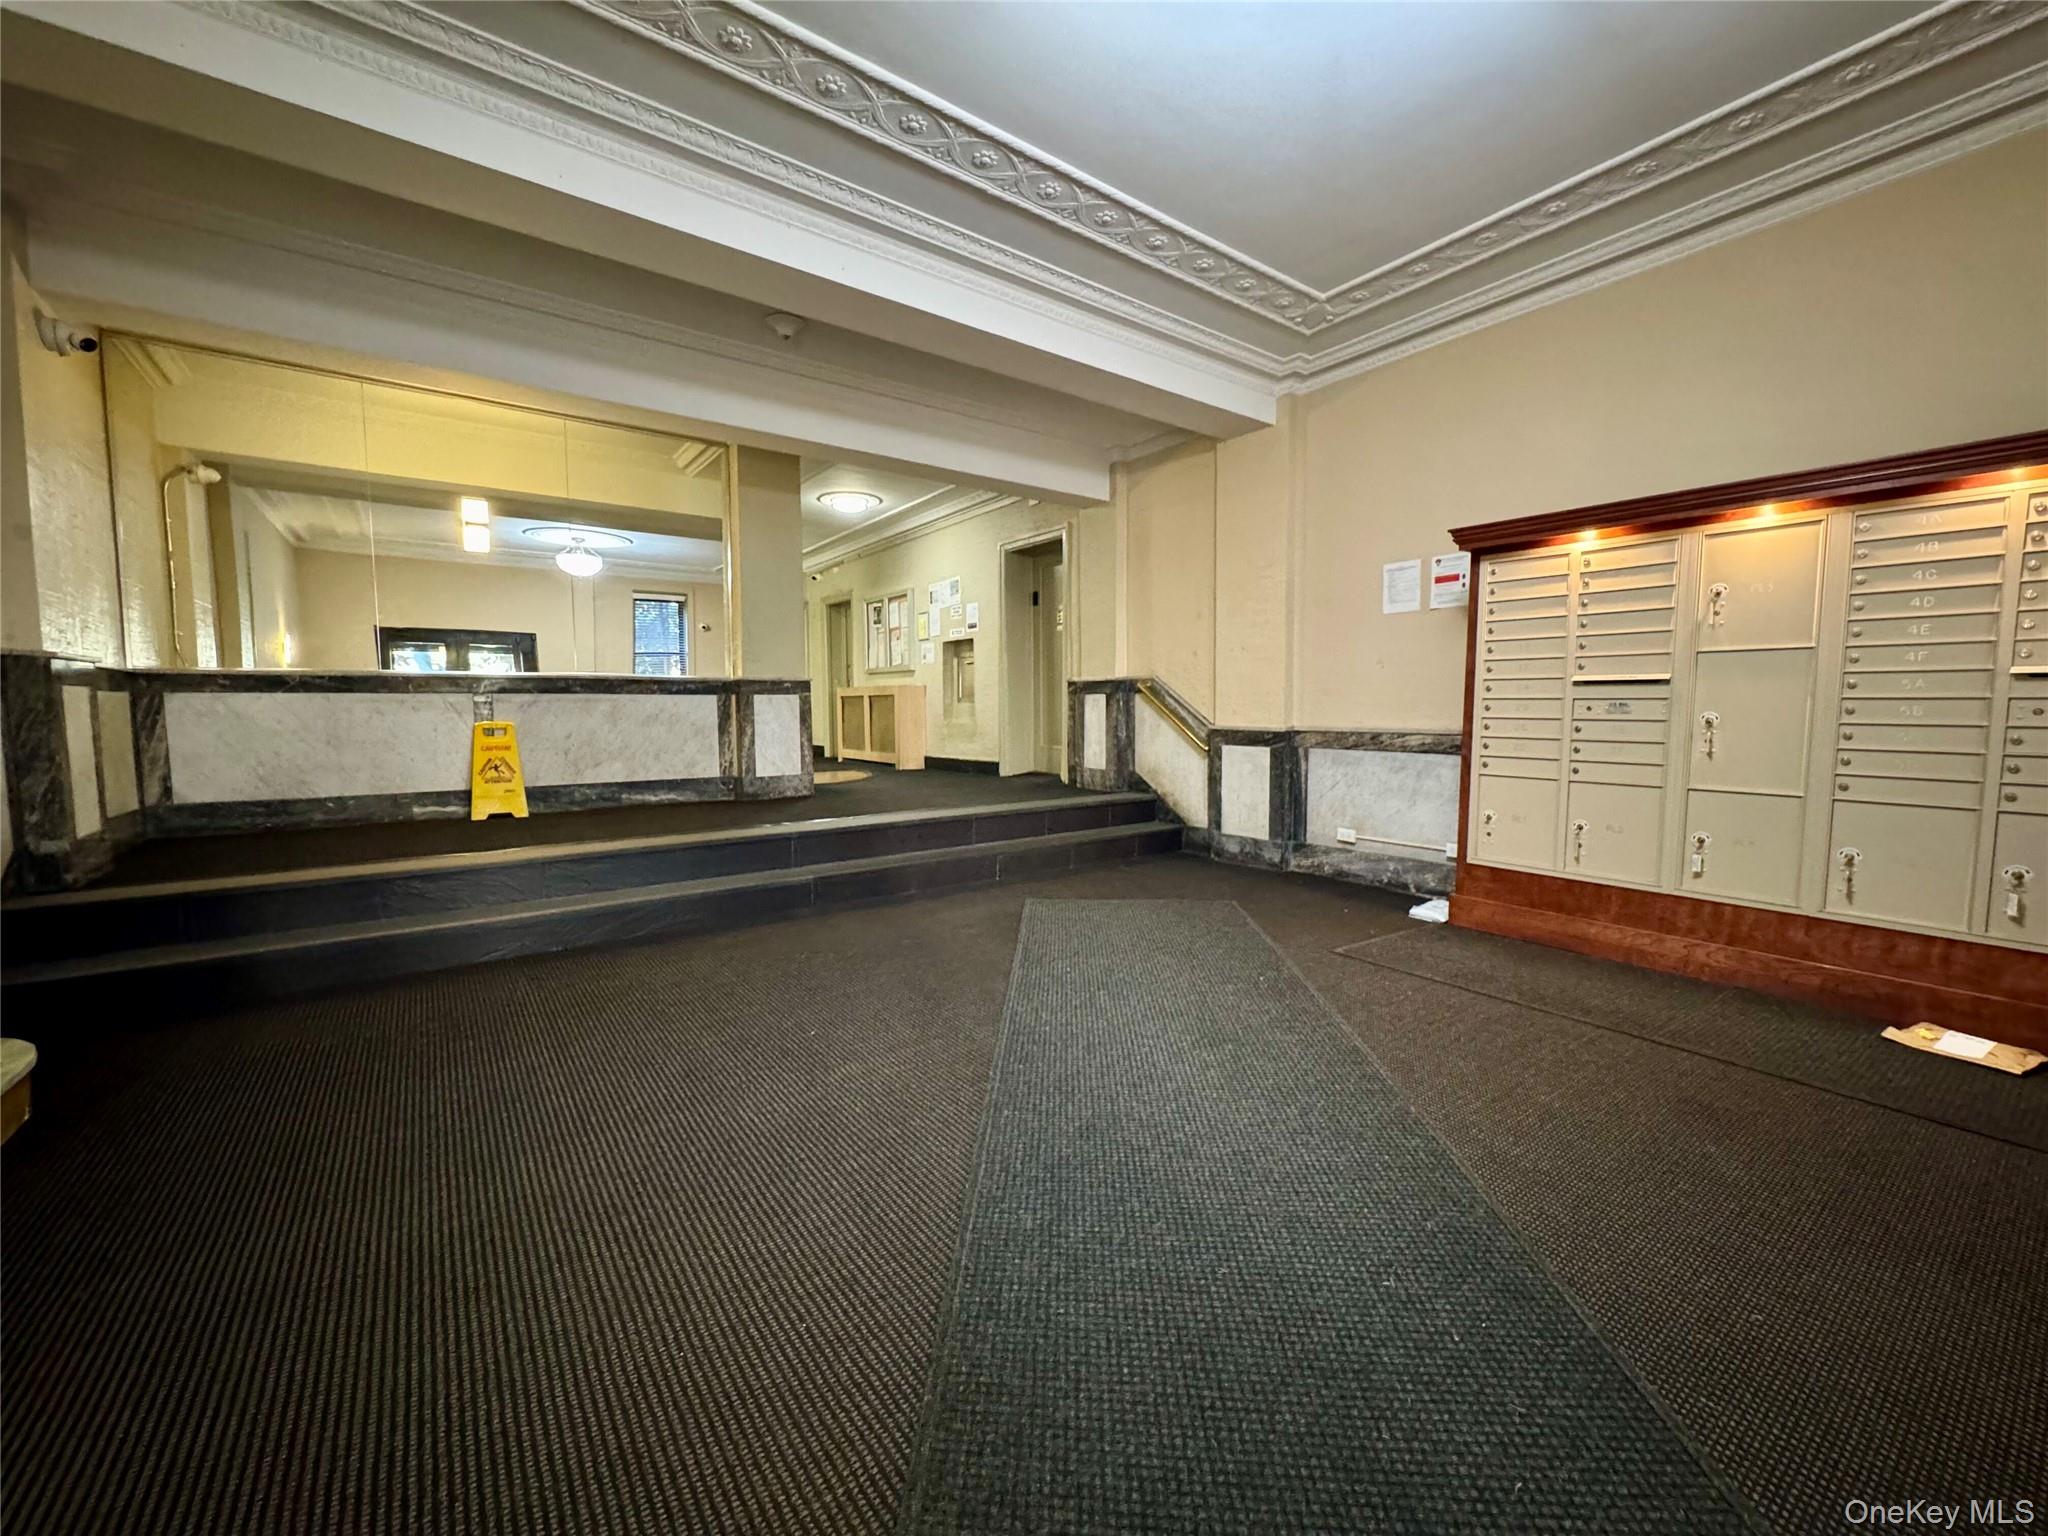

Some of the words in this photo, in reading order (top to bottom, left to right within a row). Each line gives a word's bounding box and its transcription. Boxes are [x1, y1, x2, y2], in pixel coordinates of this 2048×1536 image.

[1914, 541, 1939, 553] 4B
[1912, 569, 1938, 580] 4C
[1910, 596, 1935, 608] 4D
[1907, 624, 1932, 635] 4E
[1904, 651, 1929, 662] 4F
